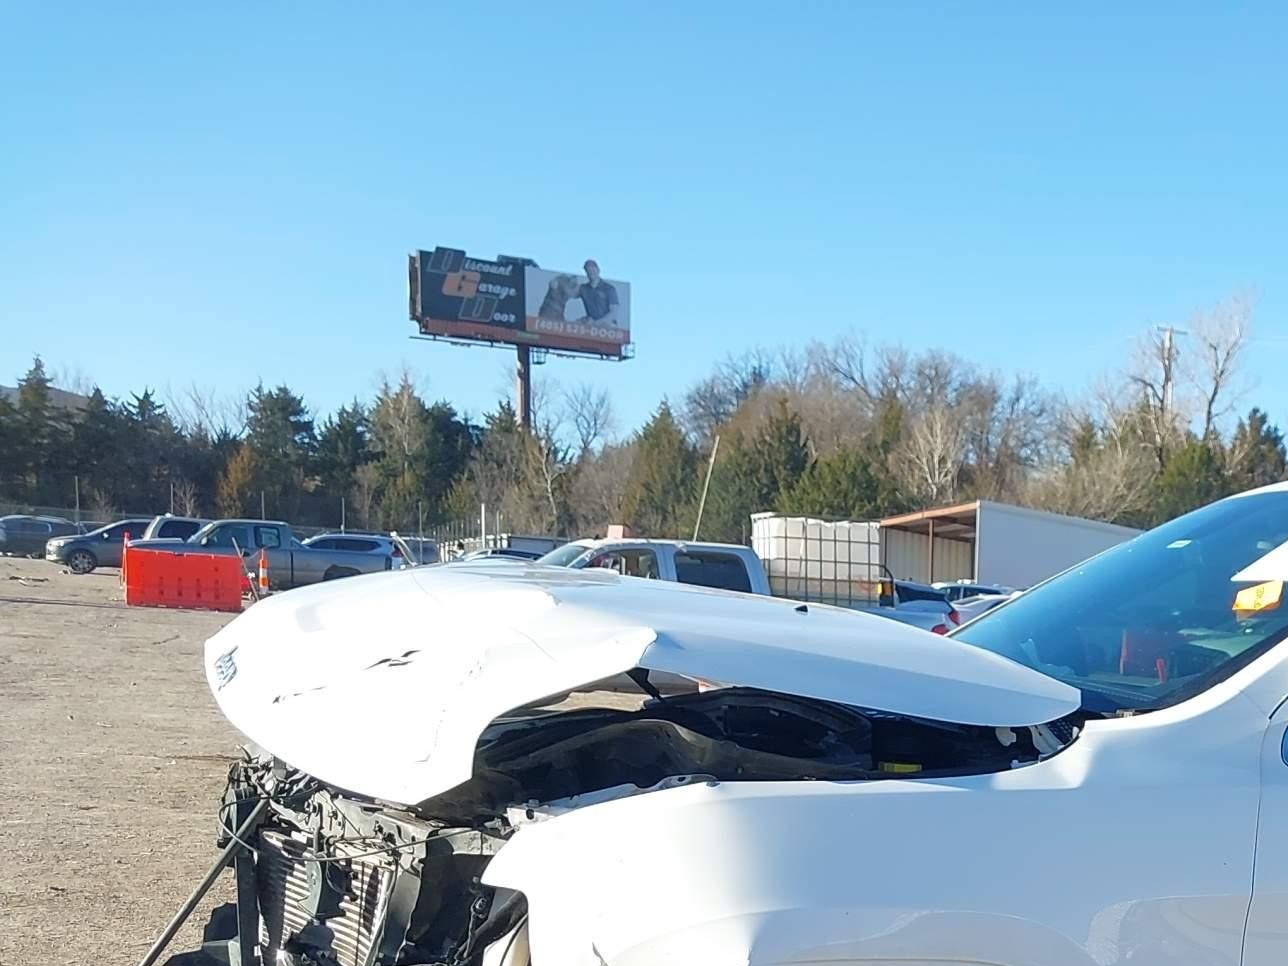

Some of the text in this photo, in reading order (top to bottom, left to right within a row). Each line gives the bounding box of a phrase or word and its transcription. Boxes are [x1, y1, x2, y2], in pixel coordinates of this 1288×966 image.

[427, 250, 513, 276] Discount
[443, 271, 517, 299] Garage
[459, 296, 516, 322] Door
